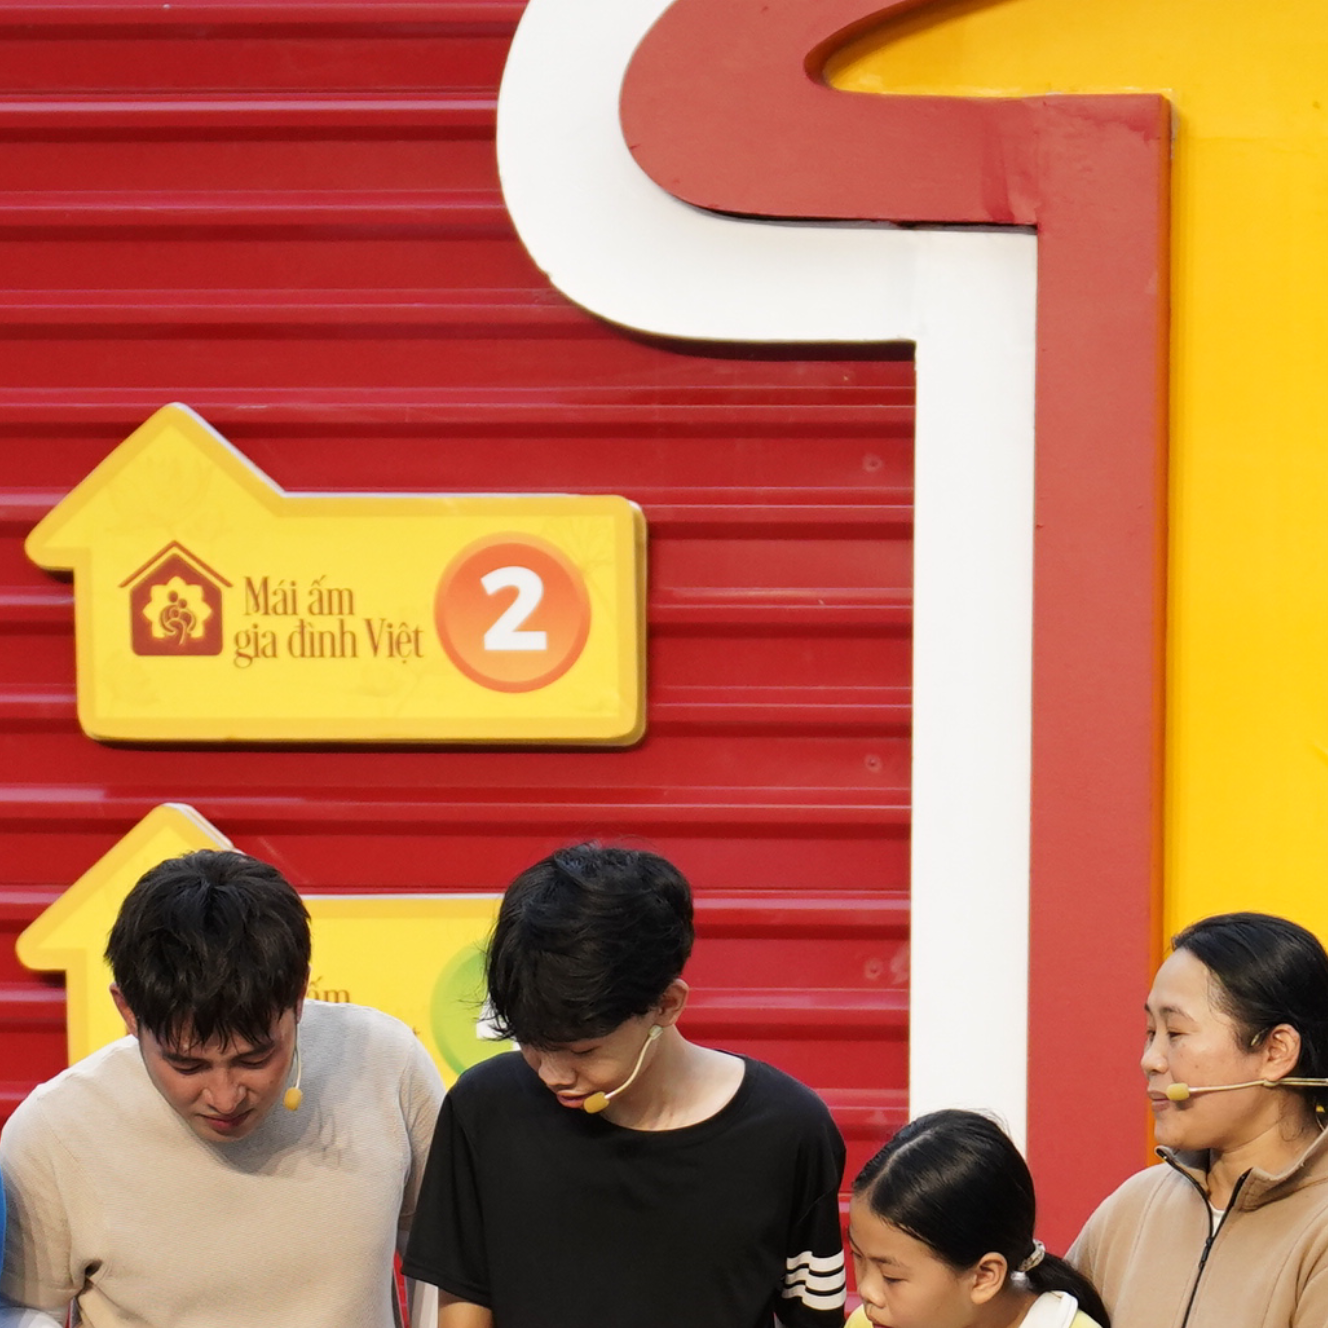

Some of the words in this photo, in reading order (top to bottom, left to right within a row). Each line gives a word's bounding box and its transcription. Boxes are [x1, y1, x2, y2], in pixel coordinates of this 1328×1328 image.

[243, 576, 301, 617] Mái
[307, 574, 355, 616] ấm
[479, 565, 548, 652] 2
[232, 621, 278, 668] gia
[287, 619, 359, 660] đình
[364, 619, 425, 665] Việt
